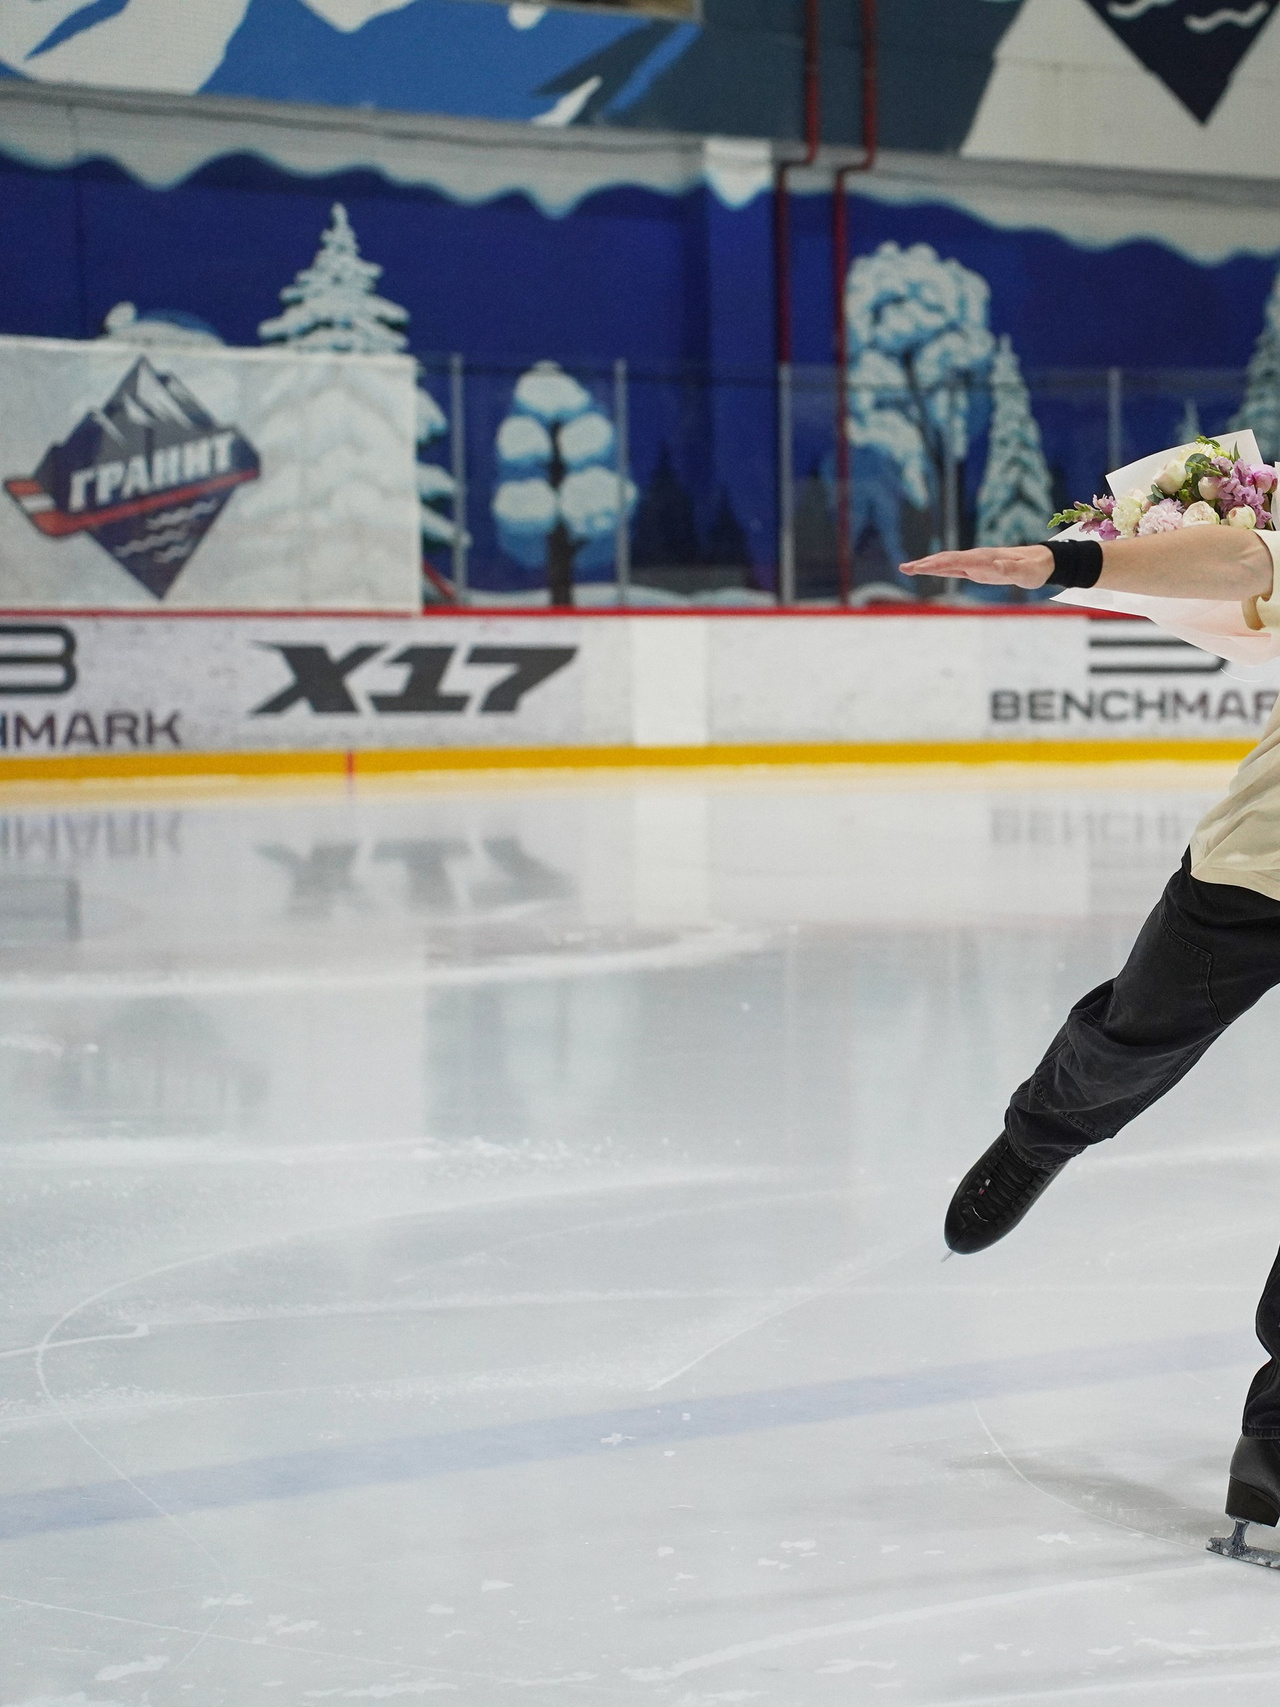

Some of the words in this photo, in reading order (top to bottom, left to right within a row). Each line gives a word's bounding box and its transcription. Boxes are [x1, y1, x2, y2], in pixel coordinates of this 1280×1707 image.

[68, 431, 236, 513] ГРАНИТ
[246, 640, 581, 718] X17
[990, 688, 1280, 723] BENCHMAR
[0, 711, 181, 747] MARK
